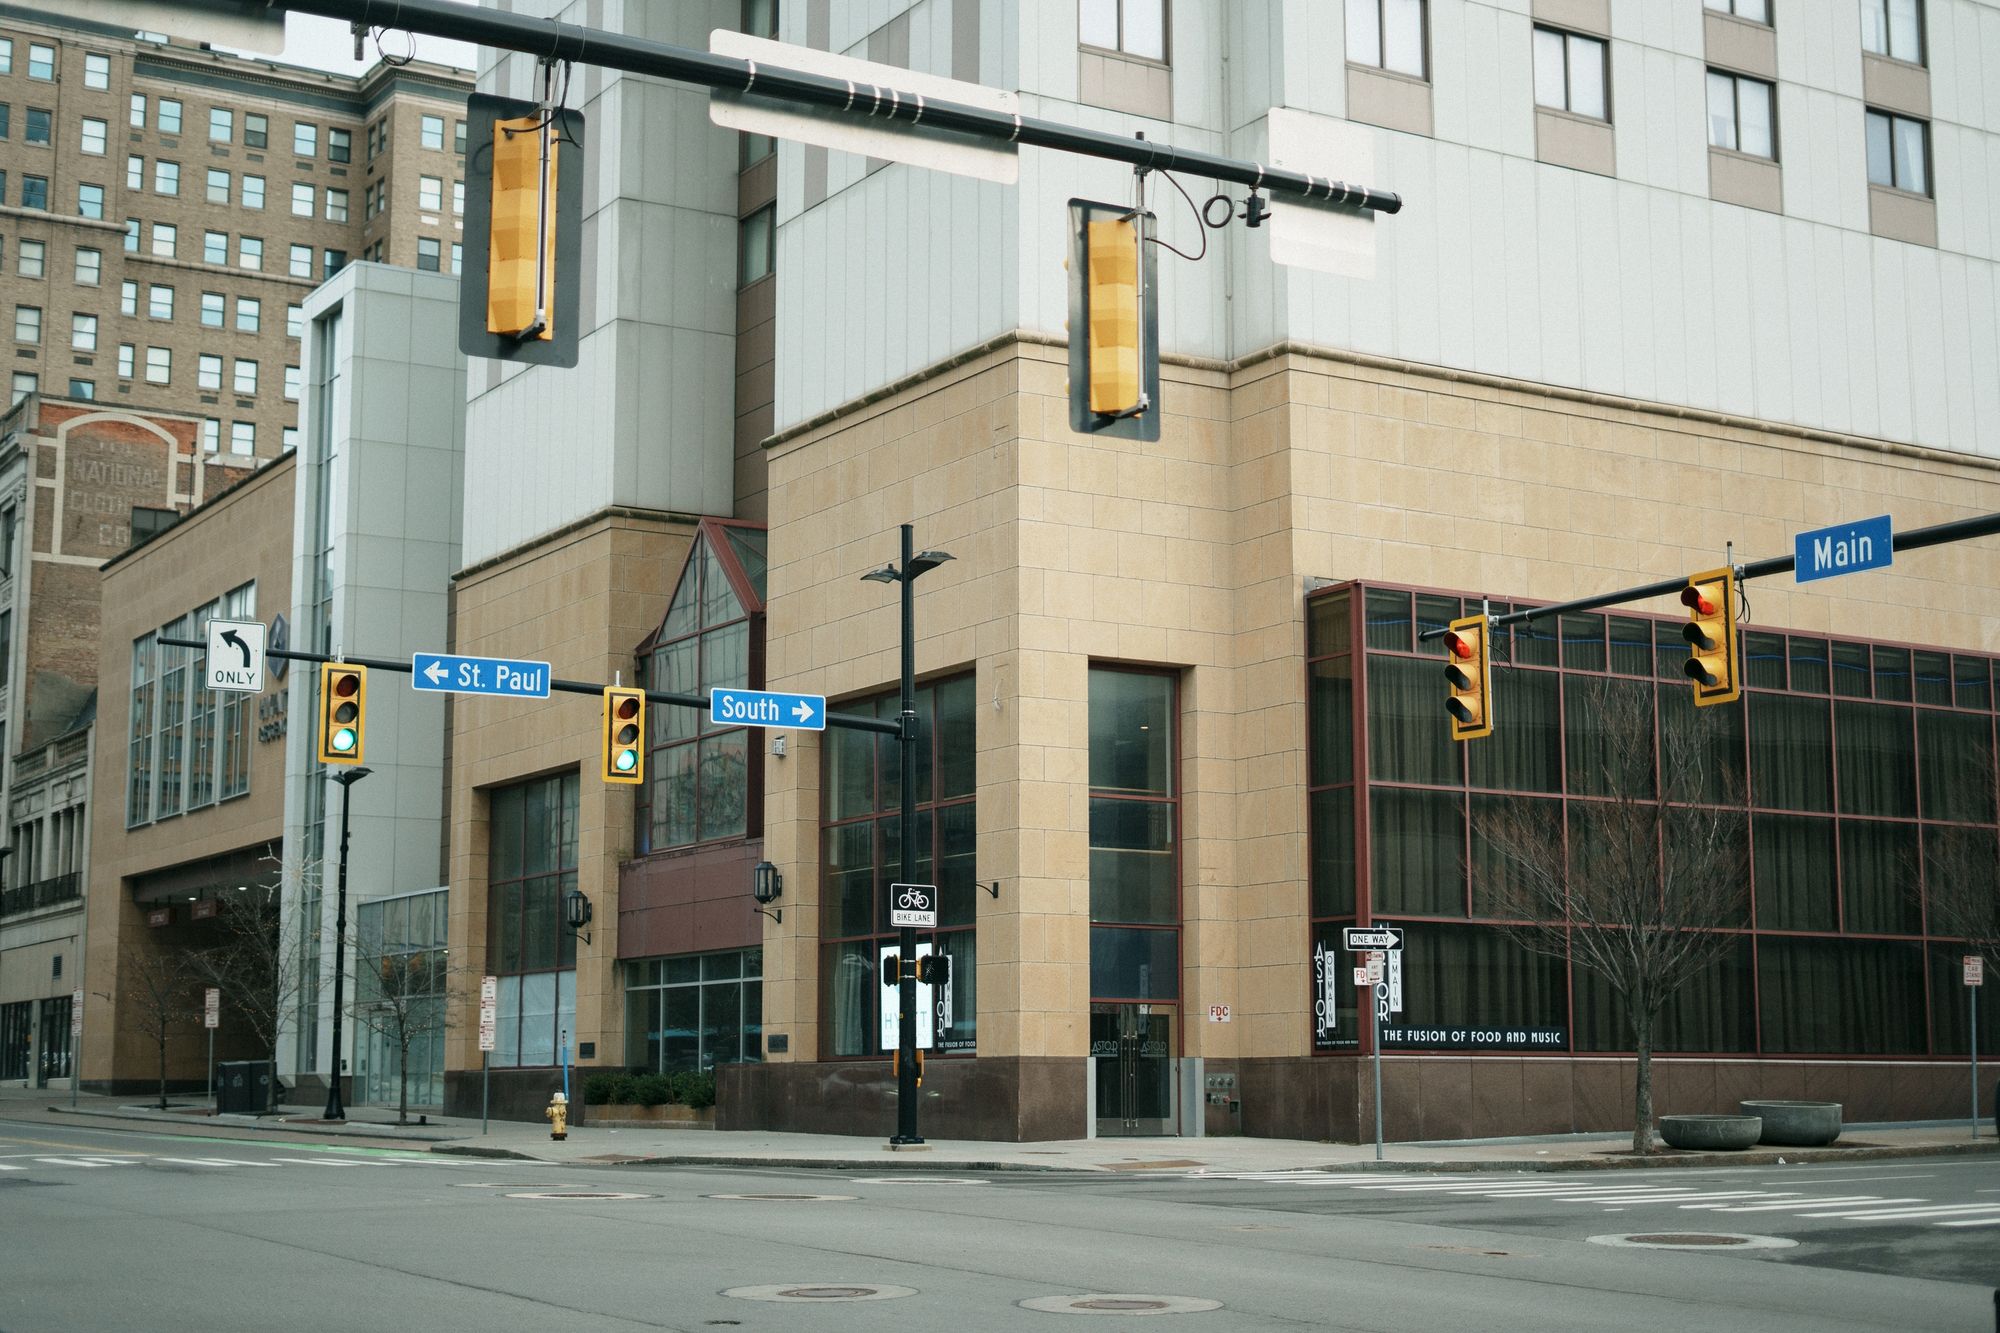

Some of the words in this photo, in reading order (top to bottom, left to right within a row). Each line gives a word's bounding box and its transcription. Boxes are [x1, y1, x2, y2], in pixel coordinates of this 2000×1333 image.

[1813, 530, 1872, 571] Main
[215, 670, 255, 685] ONLY
[457, 662, 486, 688] St.
[496, 665, 541, 692] Paul
[721, 695, 779, 721] South
[896, 912, 912, 922] BIKE
[914, 913, 931, 923] LANE
[1351, 935, 1369, 944] ONE
[1371, 935, 1389, 944] WAY
[1390, 951, 1399, 1007] N-MAIN
[1313, 941, 1326, 1038] ASTOR
[1210, 1006, 1229, 1017] FDC
[1383, 1029, 1403, 1042] THE
[1407, 1030, 1447, 1042] FUSION
[1451, 1030, 1467, 1042] OF
[1471, 1031, 1501, 1042] FOOD
[1506, 1031, 1527, 1043] AND
[1531, 1032, 1561, 1044] MUSIC
